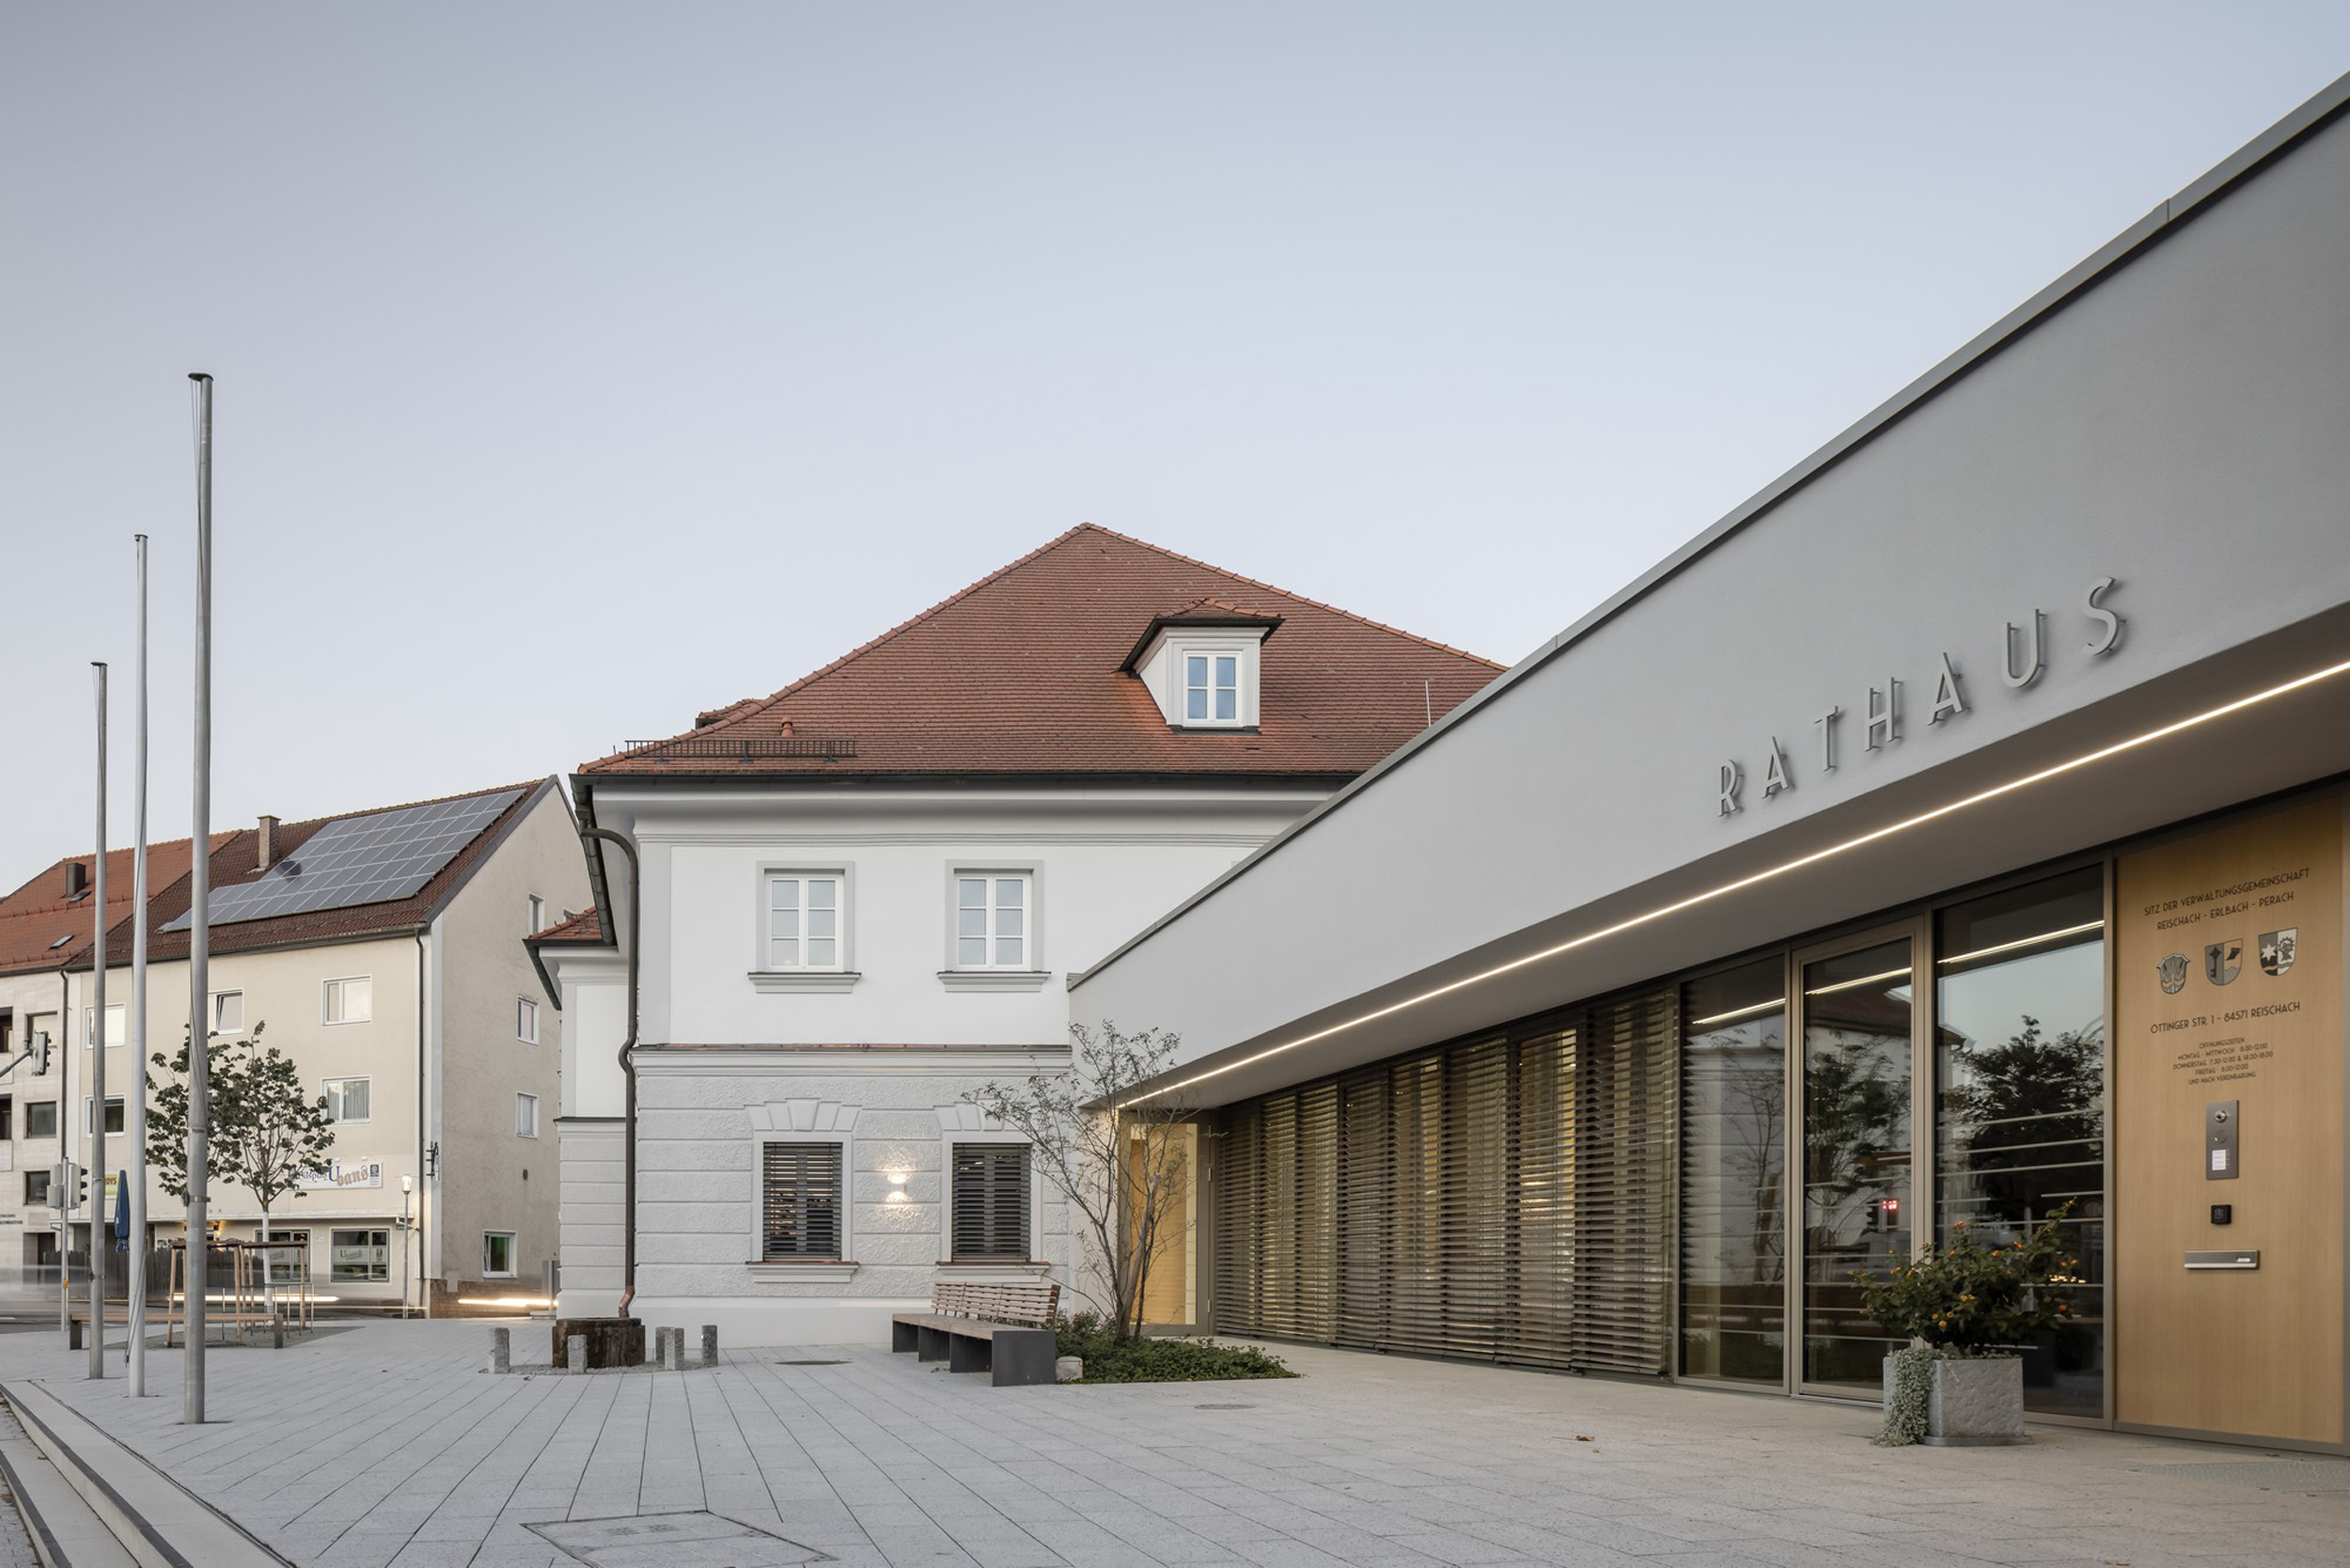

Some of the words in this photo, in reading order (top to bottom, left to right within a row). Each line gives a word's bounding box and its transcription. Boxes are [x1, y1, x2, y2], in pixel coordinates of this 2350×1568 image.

[1718, 575, 2123, 818] RATHAUS
[2143, 903, 2161, 917] SITZ
[2162, 900, 2179, 912] DER
[2181, 868, 2311, 906] VERWALTUNGSGEMEINSCHAFT
[2156, 913, 2201, 931] REISCHACH
[2210, 902, 2249, 919] ERLBACH
[2259, 890, 2295, 908] PERACH
[2224, 1010, 2248, 1022] 84571
[2250, 1001, 2301, 1017] REISCHACH
